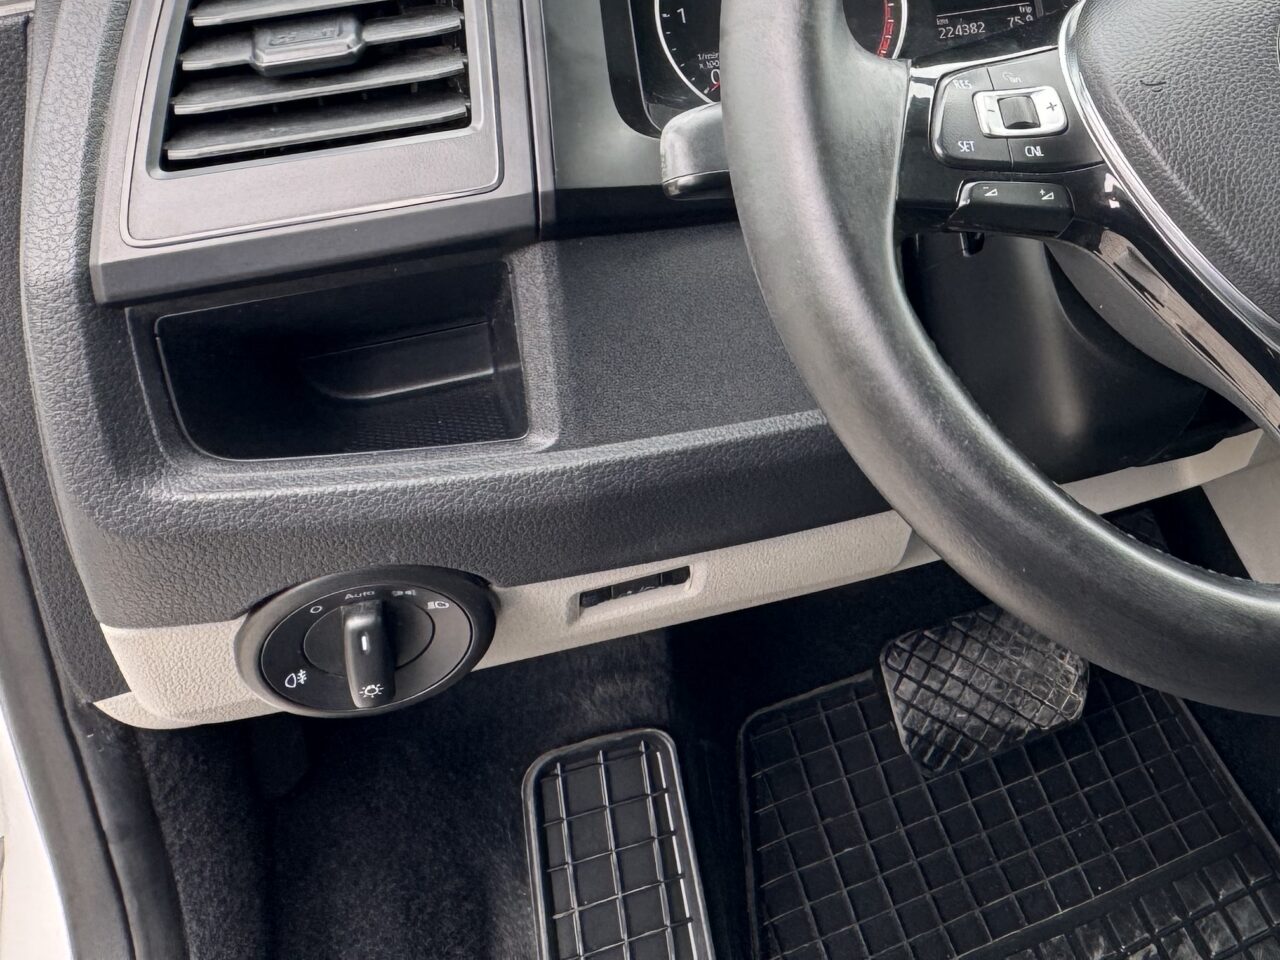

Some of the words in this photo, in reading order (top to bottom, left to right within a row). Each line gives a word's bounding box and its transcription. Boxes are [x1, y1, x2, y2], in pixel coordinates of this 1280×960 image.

[676, 8, 686, 24] 1
[938, 21, 985, 39] 224382
[953, 78, 972, 89] RES
[957, 140, 975, 153] SET
[1024, 145, 1044, 157] CNL
